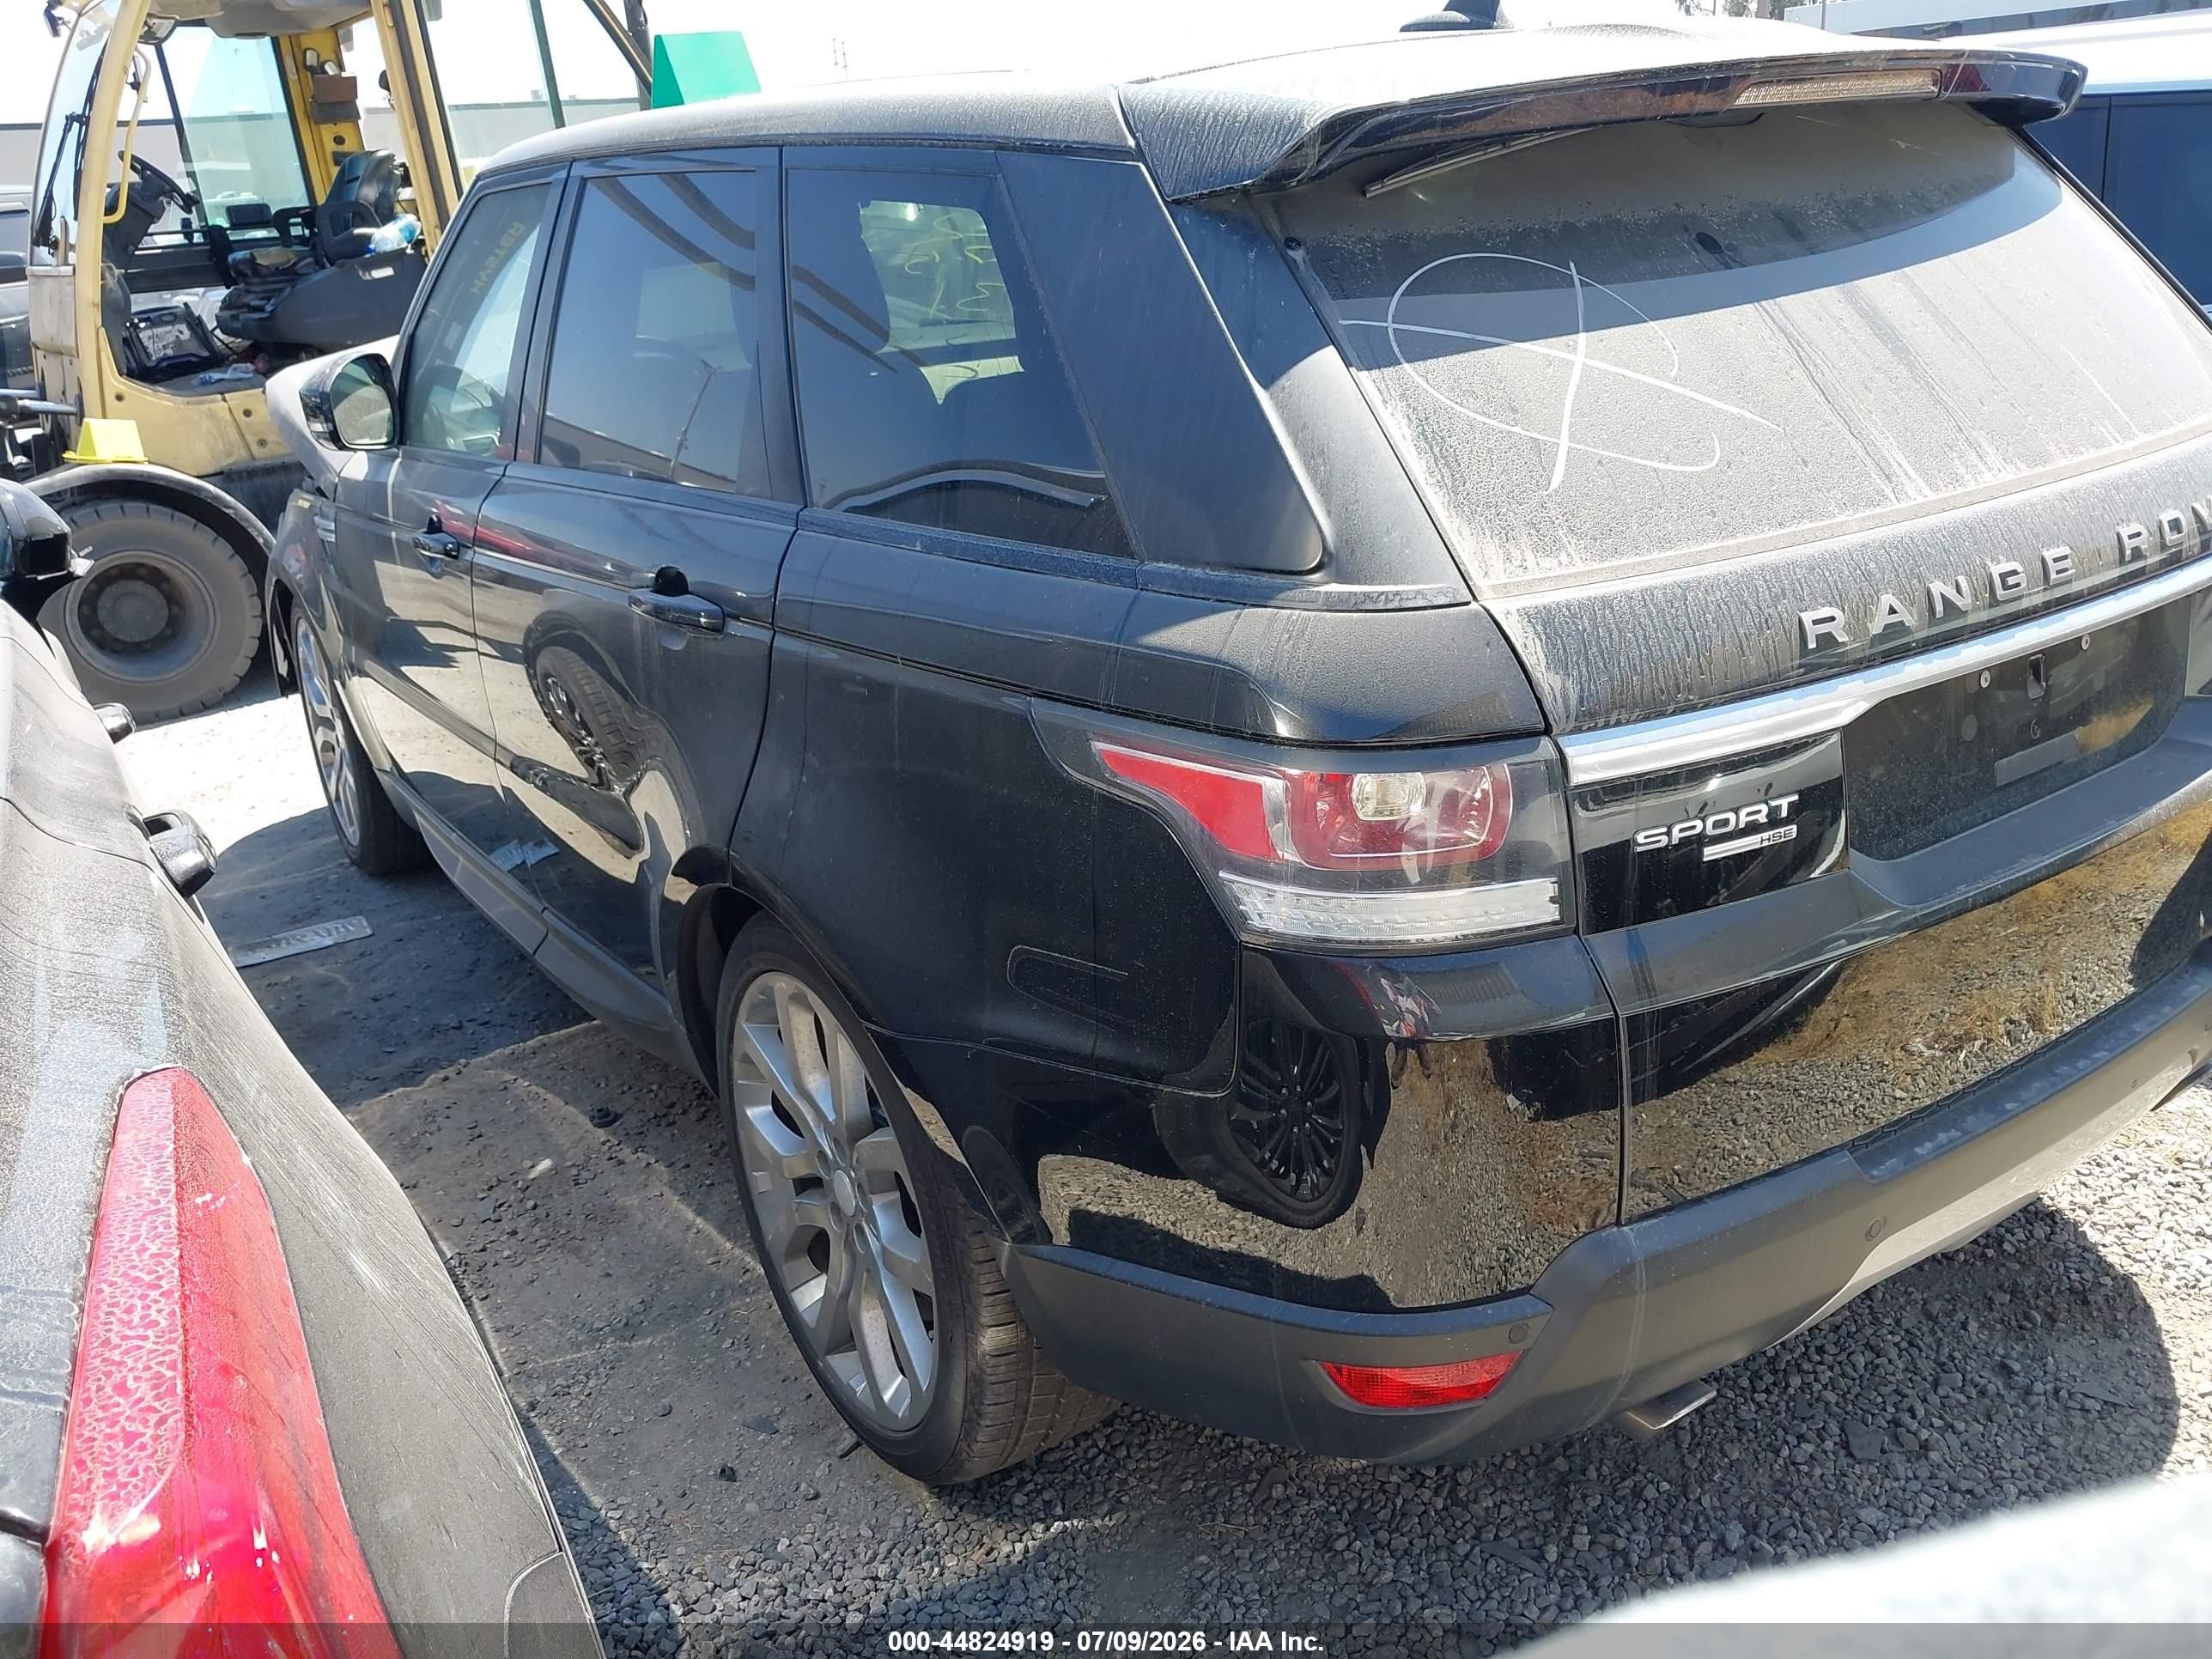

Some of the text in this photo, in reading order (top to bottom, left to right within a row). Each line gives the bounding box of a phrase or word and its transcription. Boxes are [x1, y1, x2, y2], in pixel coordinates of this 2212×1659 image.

[1798, 545, 2076, 649] RANGE
[1633, 793, 1799, 853] SPORT
[1759, 826, 1794, 846] HSE
